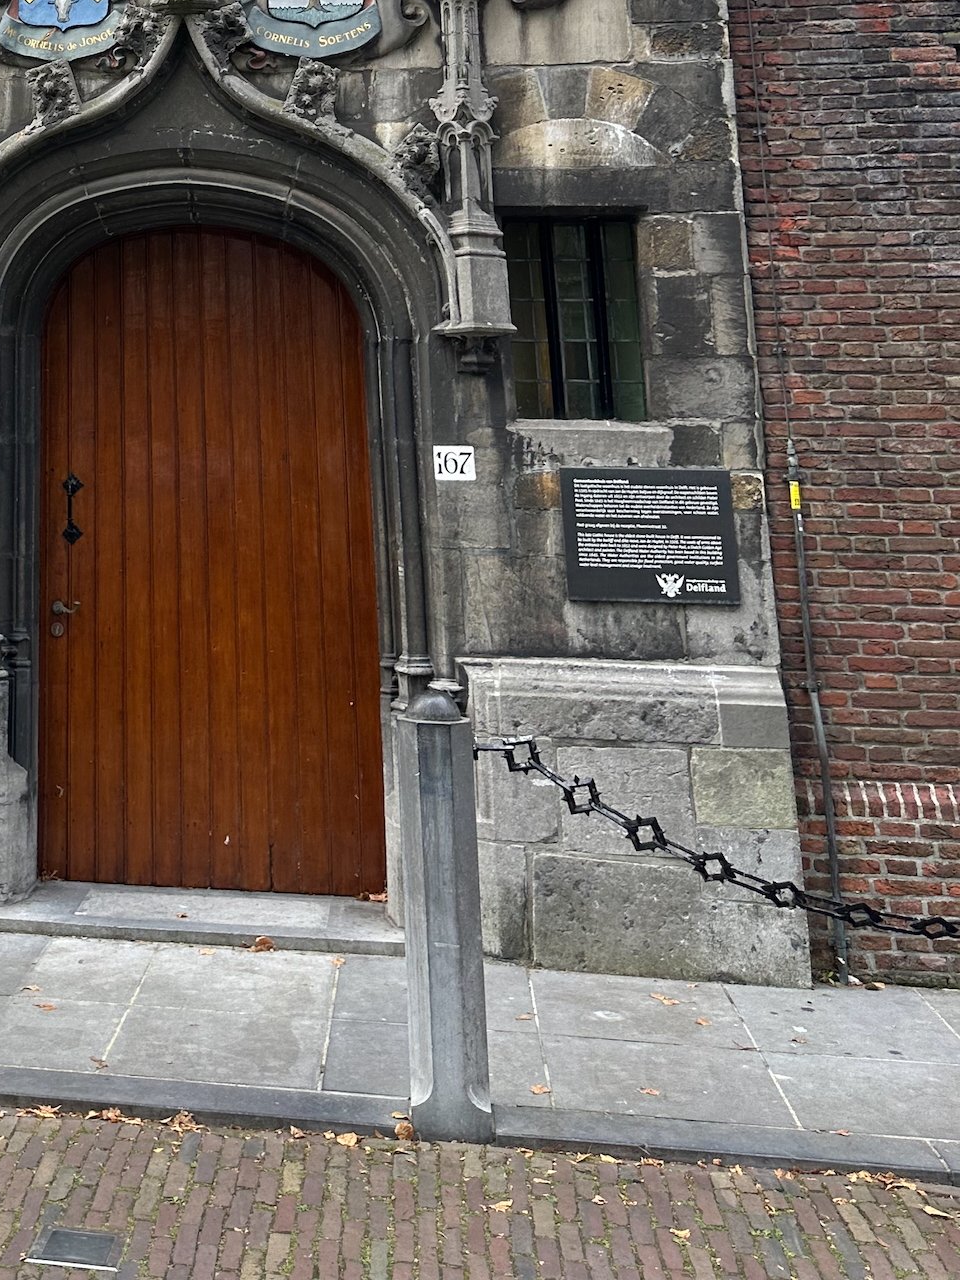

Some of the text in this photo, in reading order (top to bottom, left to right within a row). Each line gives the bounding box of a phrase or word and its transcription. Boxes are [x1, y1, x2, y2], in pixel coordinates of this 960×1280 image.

[16, 33, 64, 52] CORNELIS
[66, 41, 78, 51] de
[79, 27, 114, 48] JONGE
[256, 21, 372, 49] CORNELIS SOETENS
[436, 451, 473, 475] 167
[685, 583, 727, 593] Delfland
